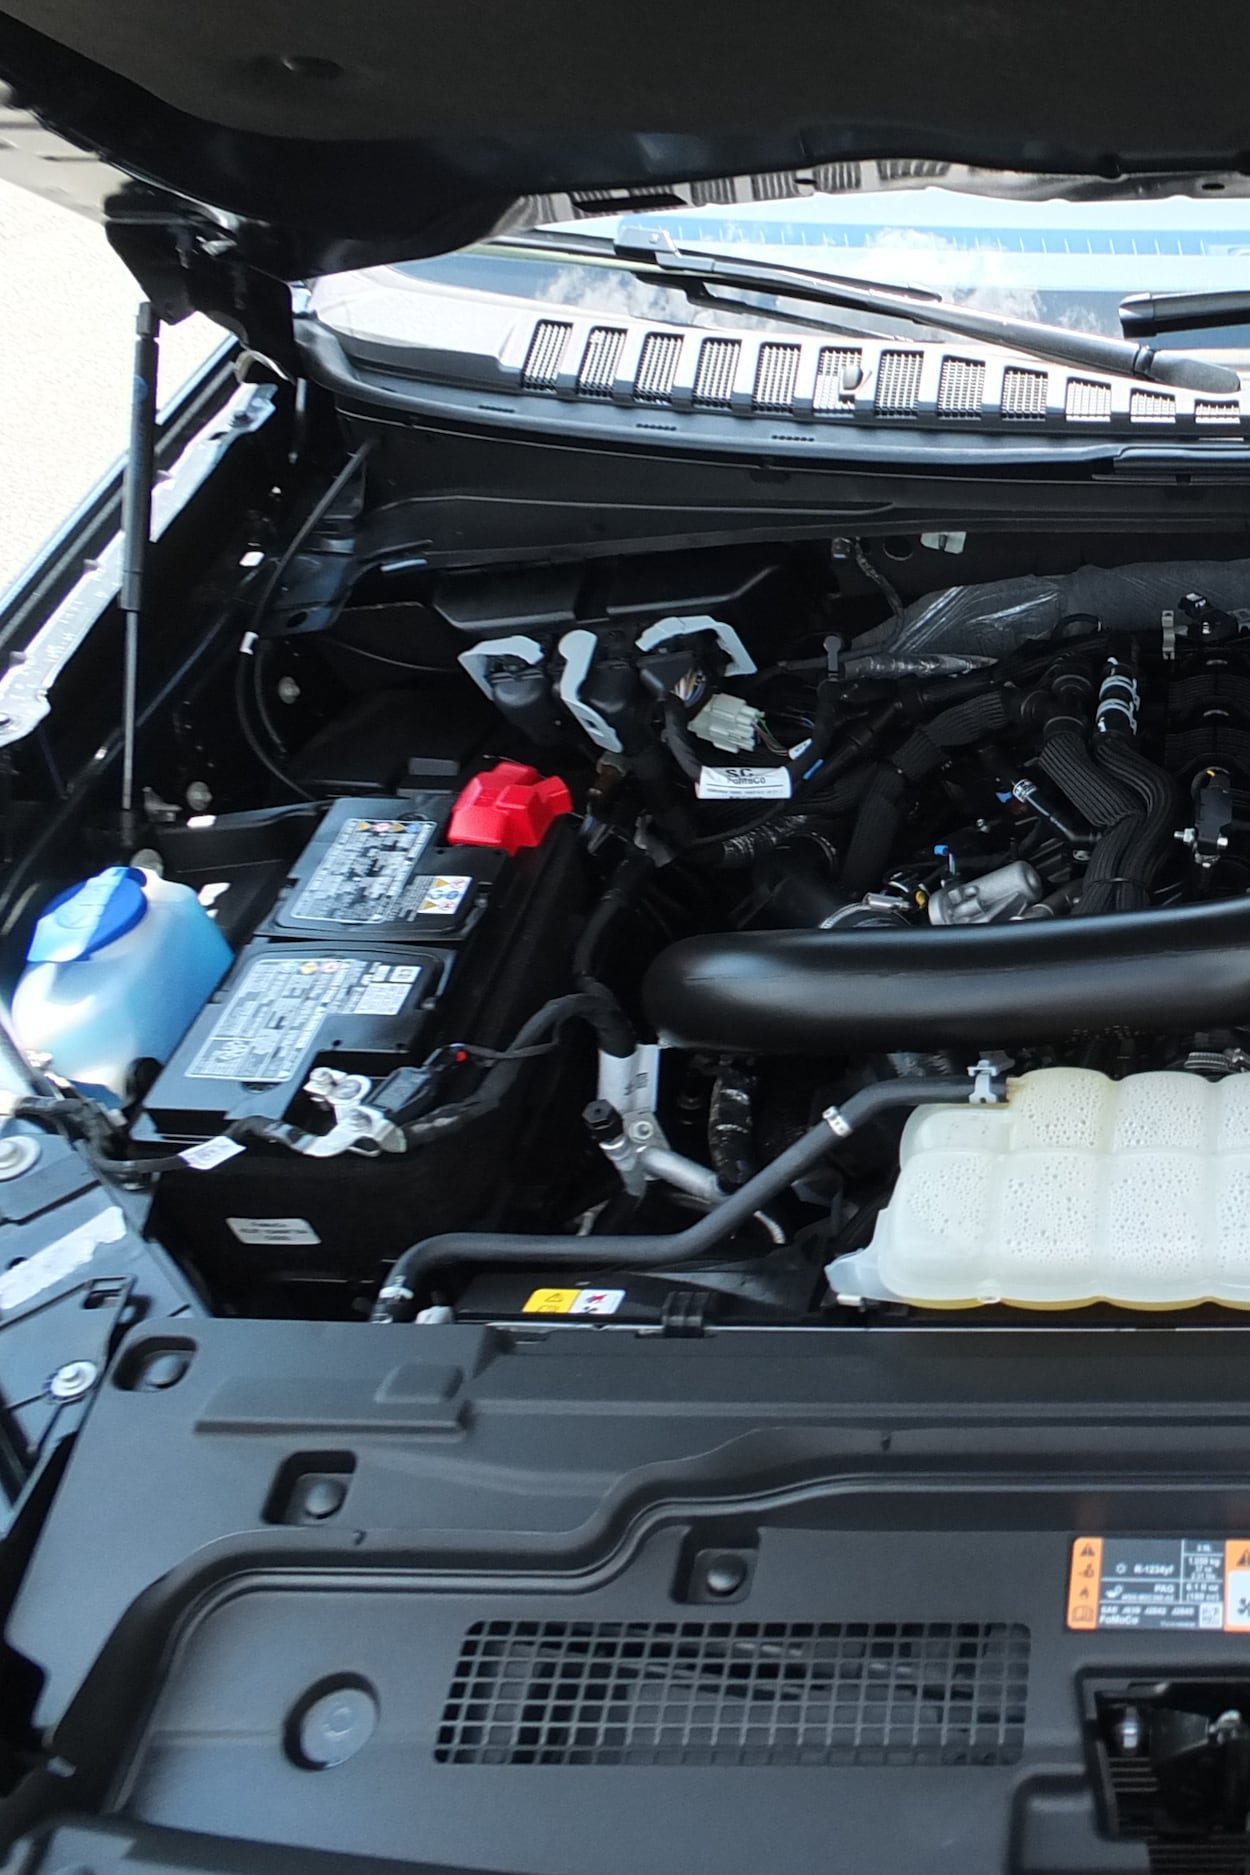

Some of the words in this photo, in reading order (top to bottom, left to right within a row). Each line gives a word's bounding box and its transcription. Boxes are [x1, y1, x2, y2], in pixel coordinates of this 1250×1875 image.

[1153, 1583, 1175, 1593] PAG
[1100, 1605, 1118, 1614] SAE
[1099, 1615, 1139, 1625] FoMoCo
